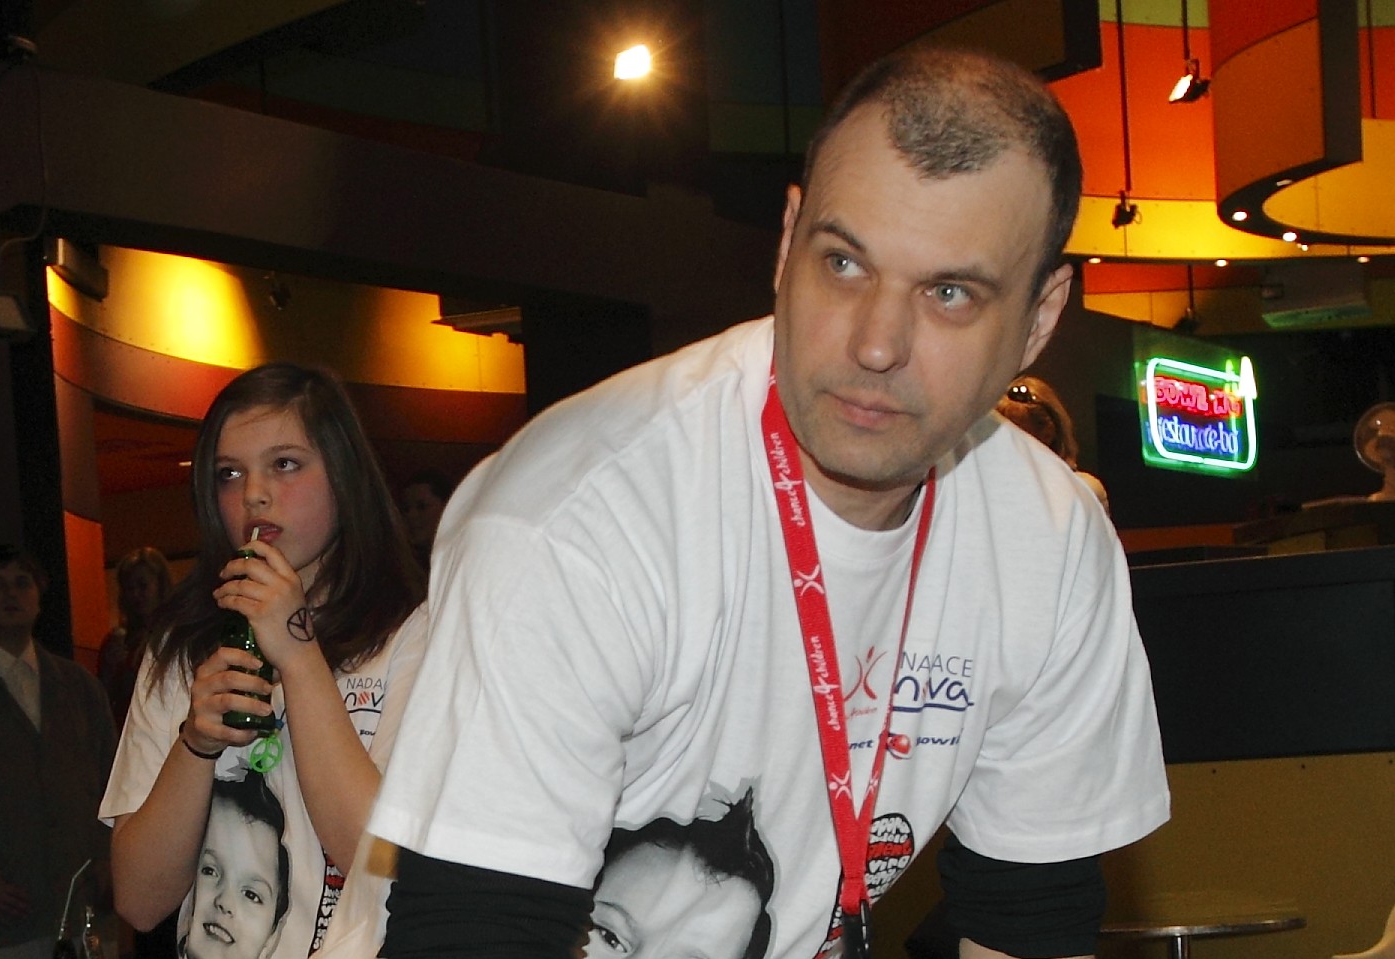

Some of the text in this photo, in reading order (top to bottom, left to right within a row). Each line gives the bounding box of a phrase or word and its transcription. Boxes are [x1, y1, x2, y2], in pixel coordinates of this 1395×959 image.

[346, 677, 387, 690] NADA
[344, 691, 385, 708] nov
[848, 739, 874, 750] net
